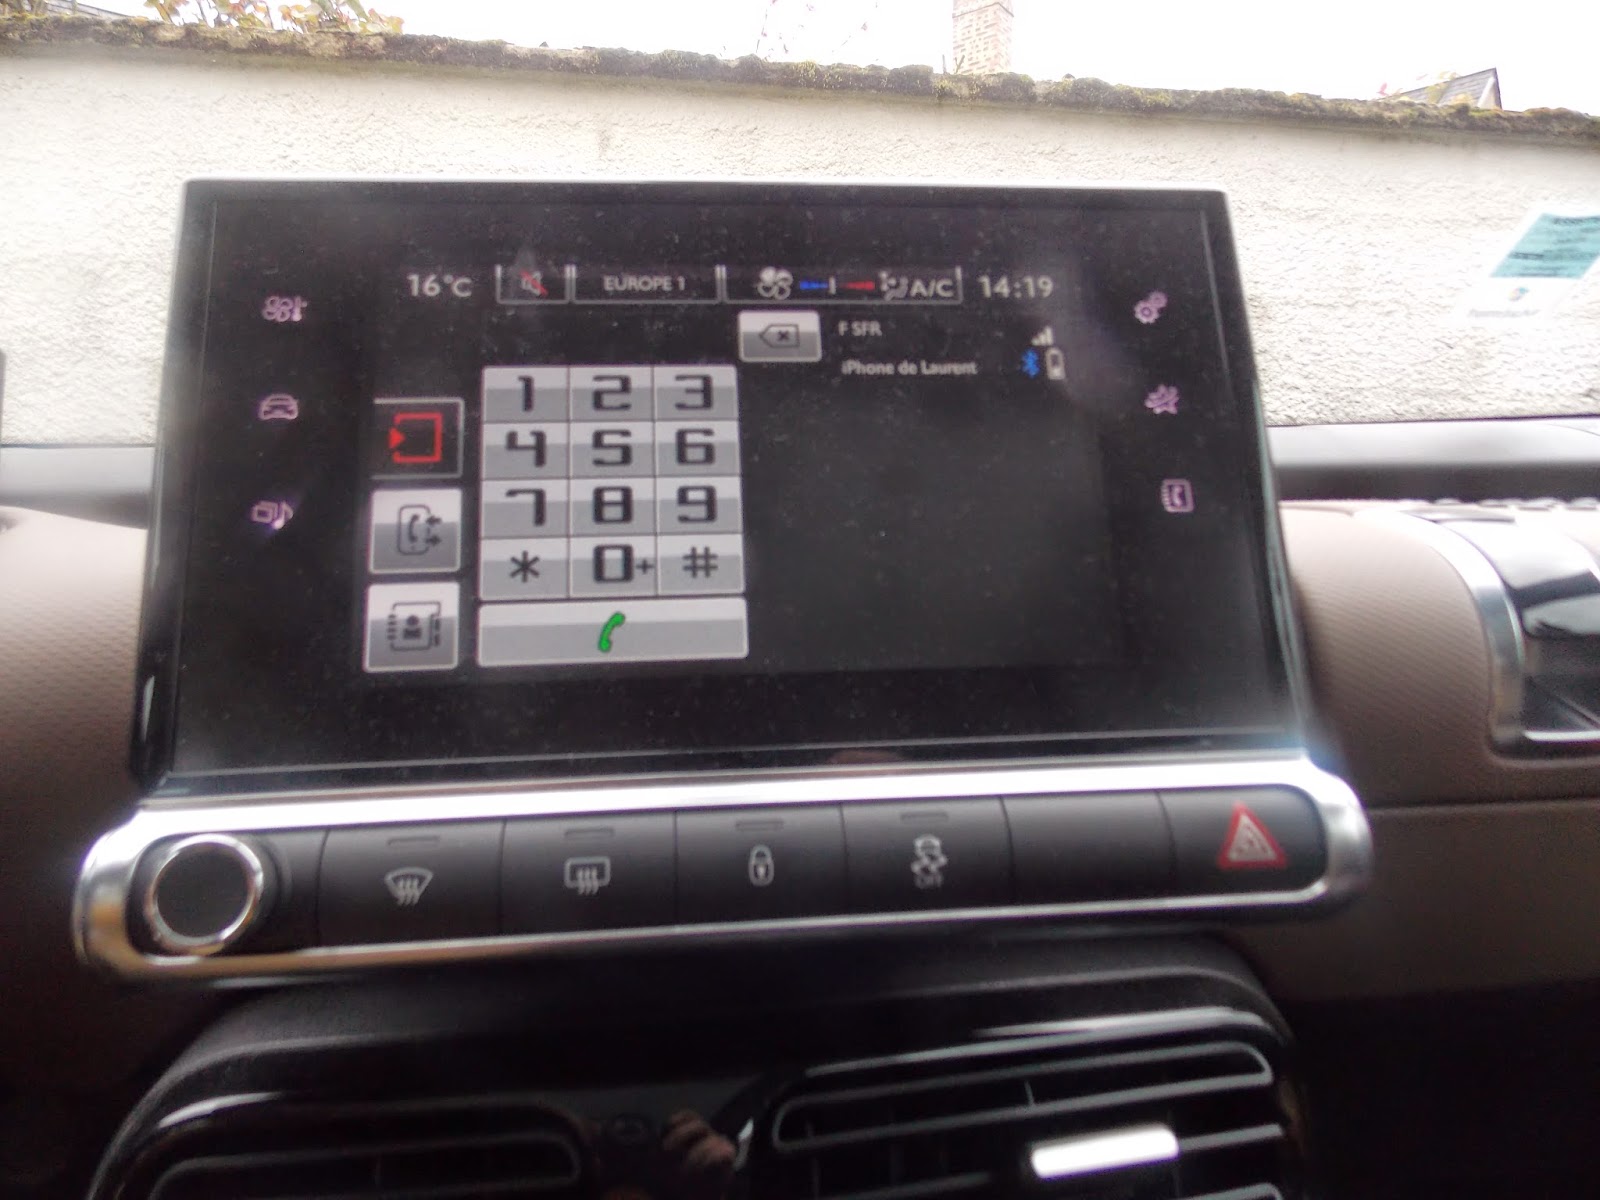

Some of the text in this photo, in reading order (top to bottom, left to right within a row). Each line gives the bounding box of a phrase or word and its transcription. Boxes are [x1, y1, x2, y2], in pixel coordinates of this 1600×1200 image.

[603, 275, 686, 292] EUROPE 1
[910, 278, 954, 297] A/C
[978, 275, 1054, 298] 14:19
[838, 320, 882, 337] F SFR
[841, 359, 978, 376] iPhone de Laurent
[517, 374, 714, 412] 1 2 3
[506, 428, 715, 468] 4 5 6
[505, 485, 718, 527] 7 8 9
